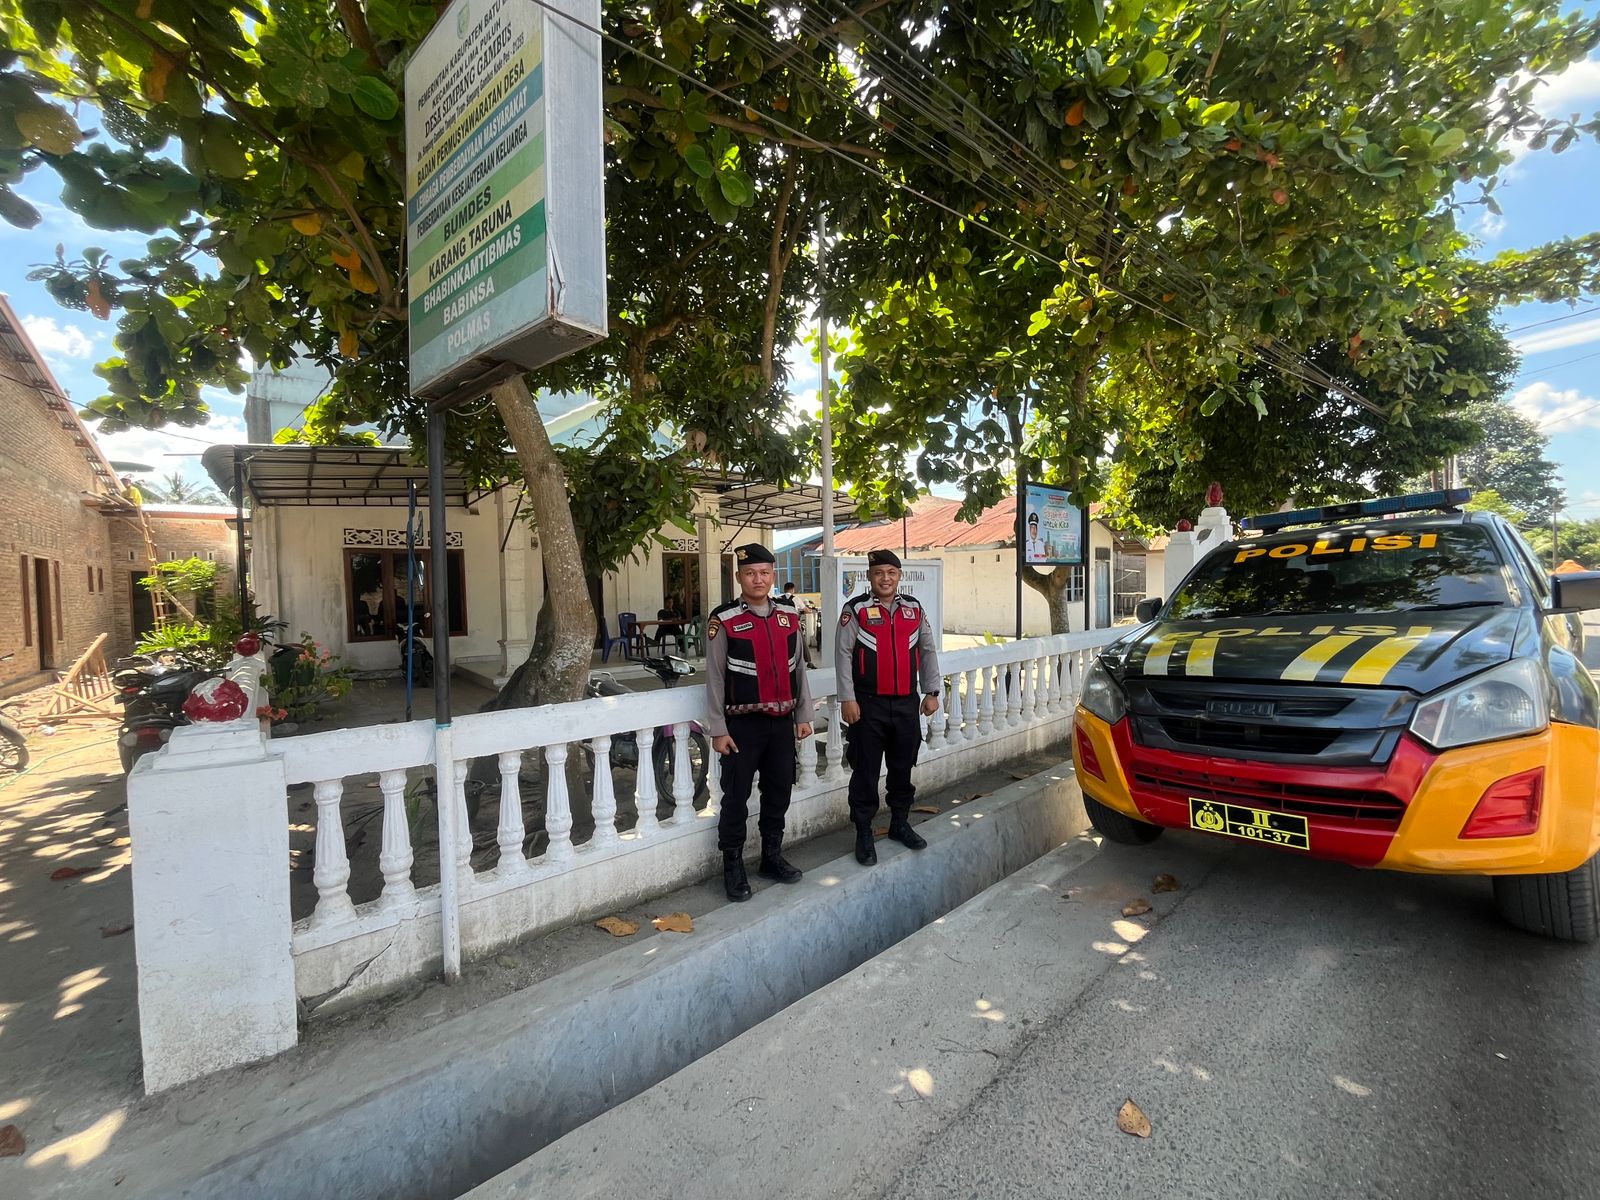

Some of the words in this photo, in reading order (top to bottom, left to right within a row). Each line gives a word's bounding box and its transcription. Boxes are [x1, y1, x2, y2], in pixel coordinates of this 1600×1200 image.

[417, 62, 448, 112] PEMERINTAH
[450, 19, 482, 71] KABUPATEN
[484, 0, 500, 29] BATU
[425, 104, 441, 138] DESA
[442, 64, 475, 118] SIMPANG
[477, 21, 511, 78] GAMBUS
[432, 62, 463, 109] KECAMATAN
[464, 43, 478, 70] LIMA
[479, 17, 500, 52] PULUH
[417, 153, 435, 187] BADAN
[436, 80, 502, 166] PERMUSYAWARATAN
[504, 56, 524, 95] DESA
[483, 85, 527, 147] MASYARAKAT
[451, 150, 494, 206] KESEJAHTERAAN
[495, 118, 527, 166] KELUARGA
[428, 235, 466, 283] KARANG
[468, 196, 512, 251] TARUNA
[443, 183, 491, 242] BUMDES
[423, 222, 521, 313] BHABINKAMTIBMAS
[443, 272, 494, 326] BABINSA
[447, 308, 490, 353] POLMAS
[1233, 533, 1438, 564] POLISI
[1161, 625, 1432, 641] POLISI
[1238, 826, 1291, 844] 101-37
[1251, 810, 1272, 829] II
